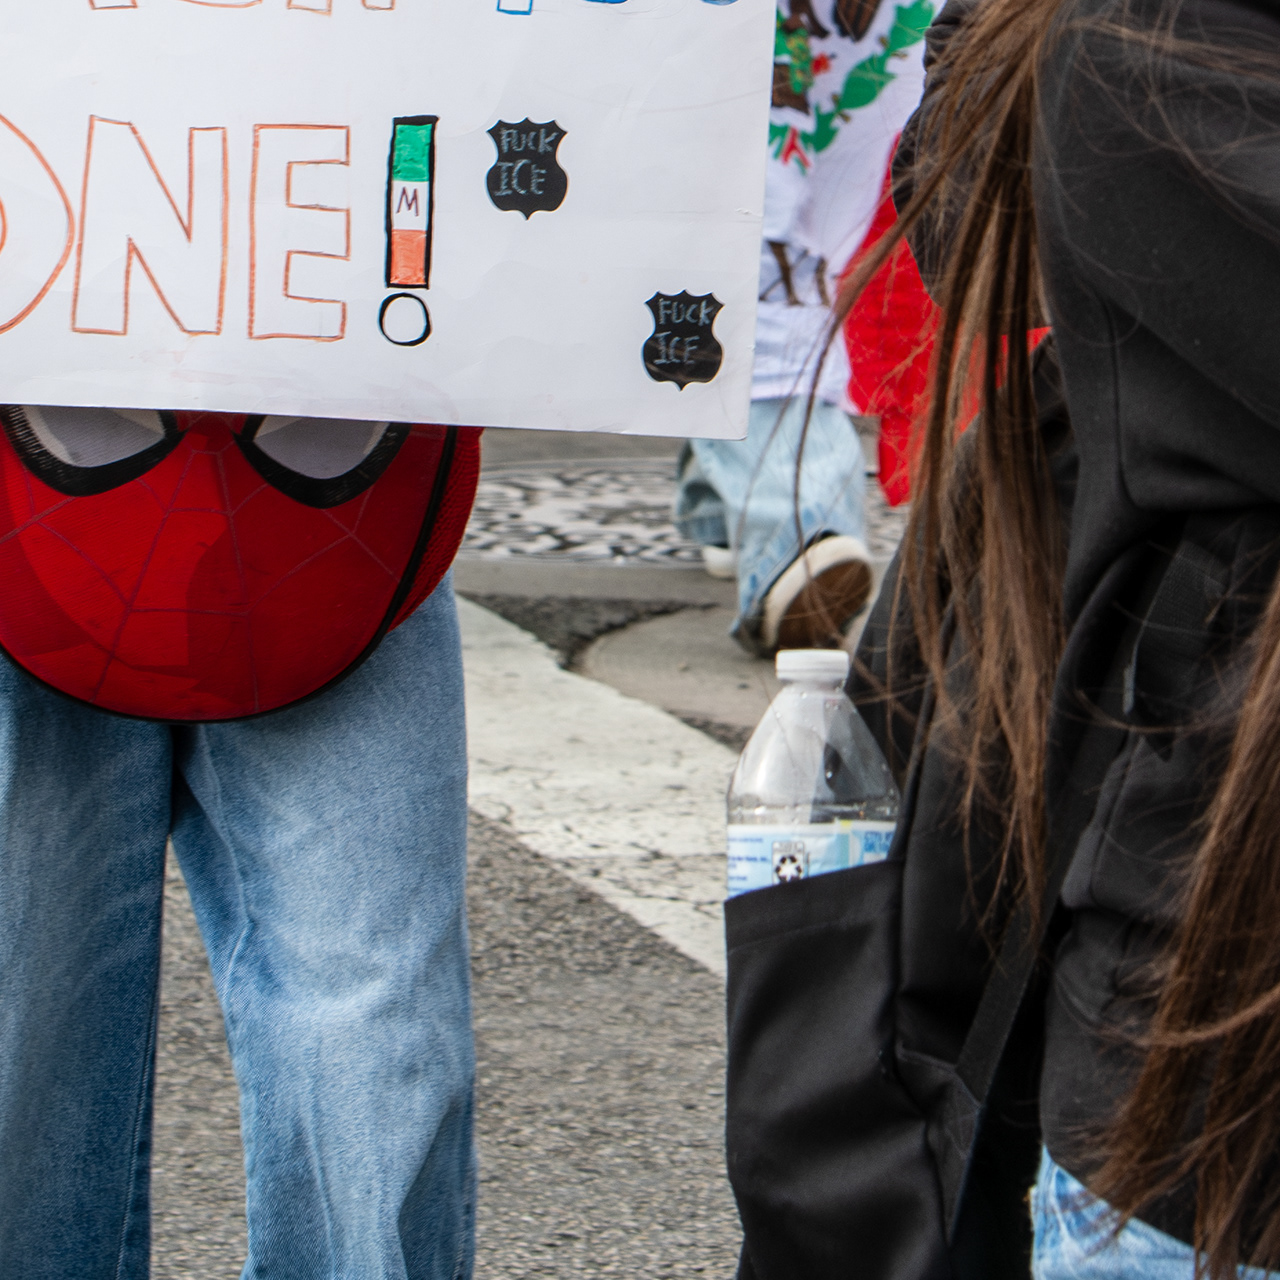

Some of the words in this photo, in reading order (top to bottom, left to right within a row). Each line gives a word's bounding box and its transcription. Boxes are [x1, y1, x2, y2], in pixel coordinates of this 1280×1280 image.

[500, 127, 559, 154] FUCK
[494, 158, 548, 196] ICE
[658, 298, 714, 327] FUCK
[653, 331, 701, 366] ICE
